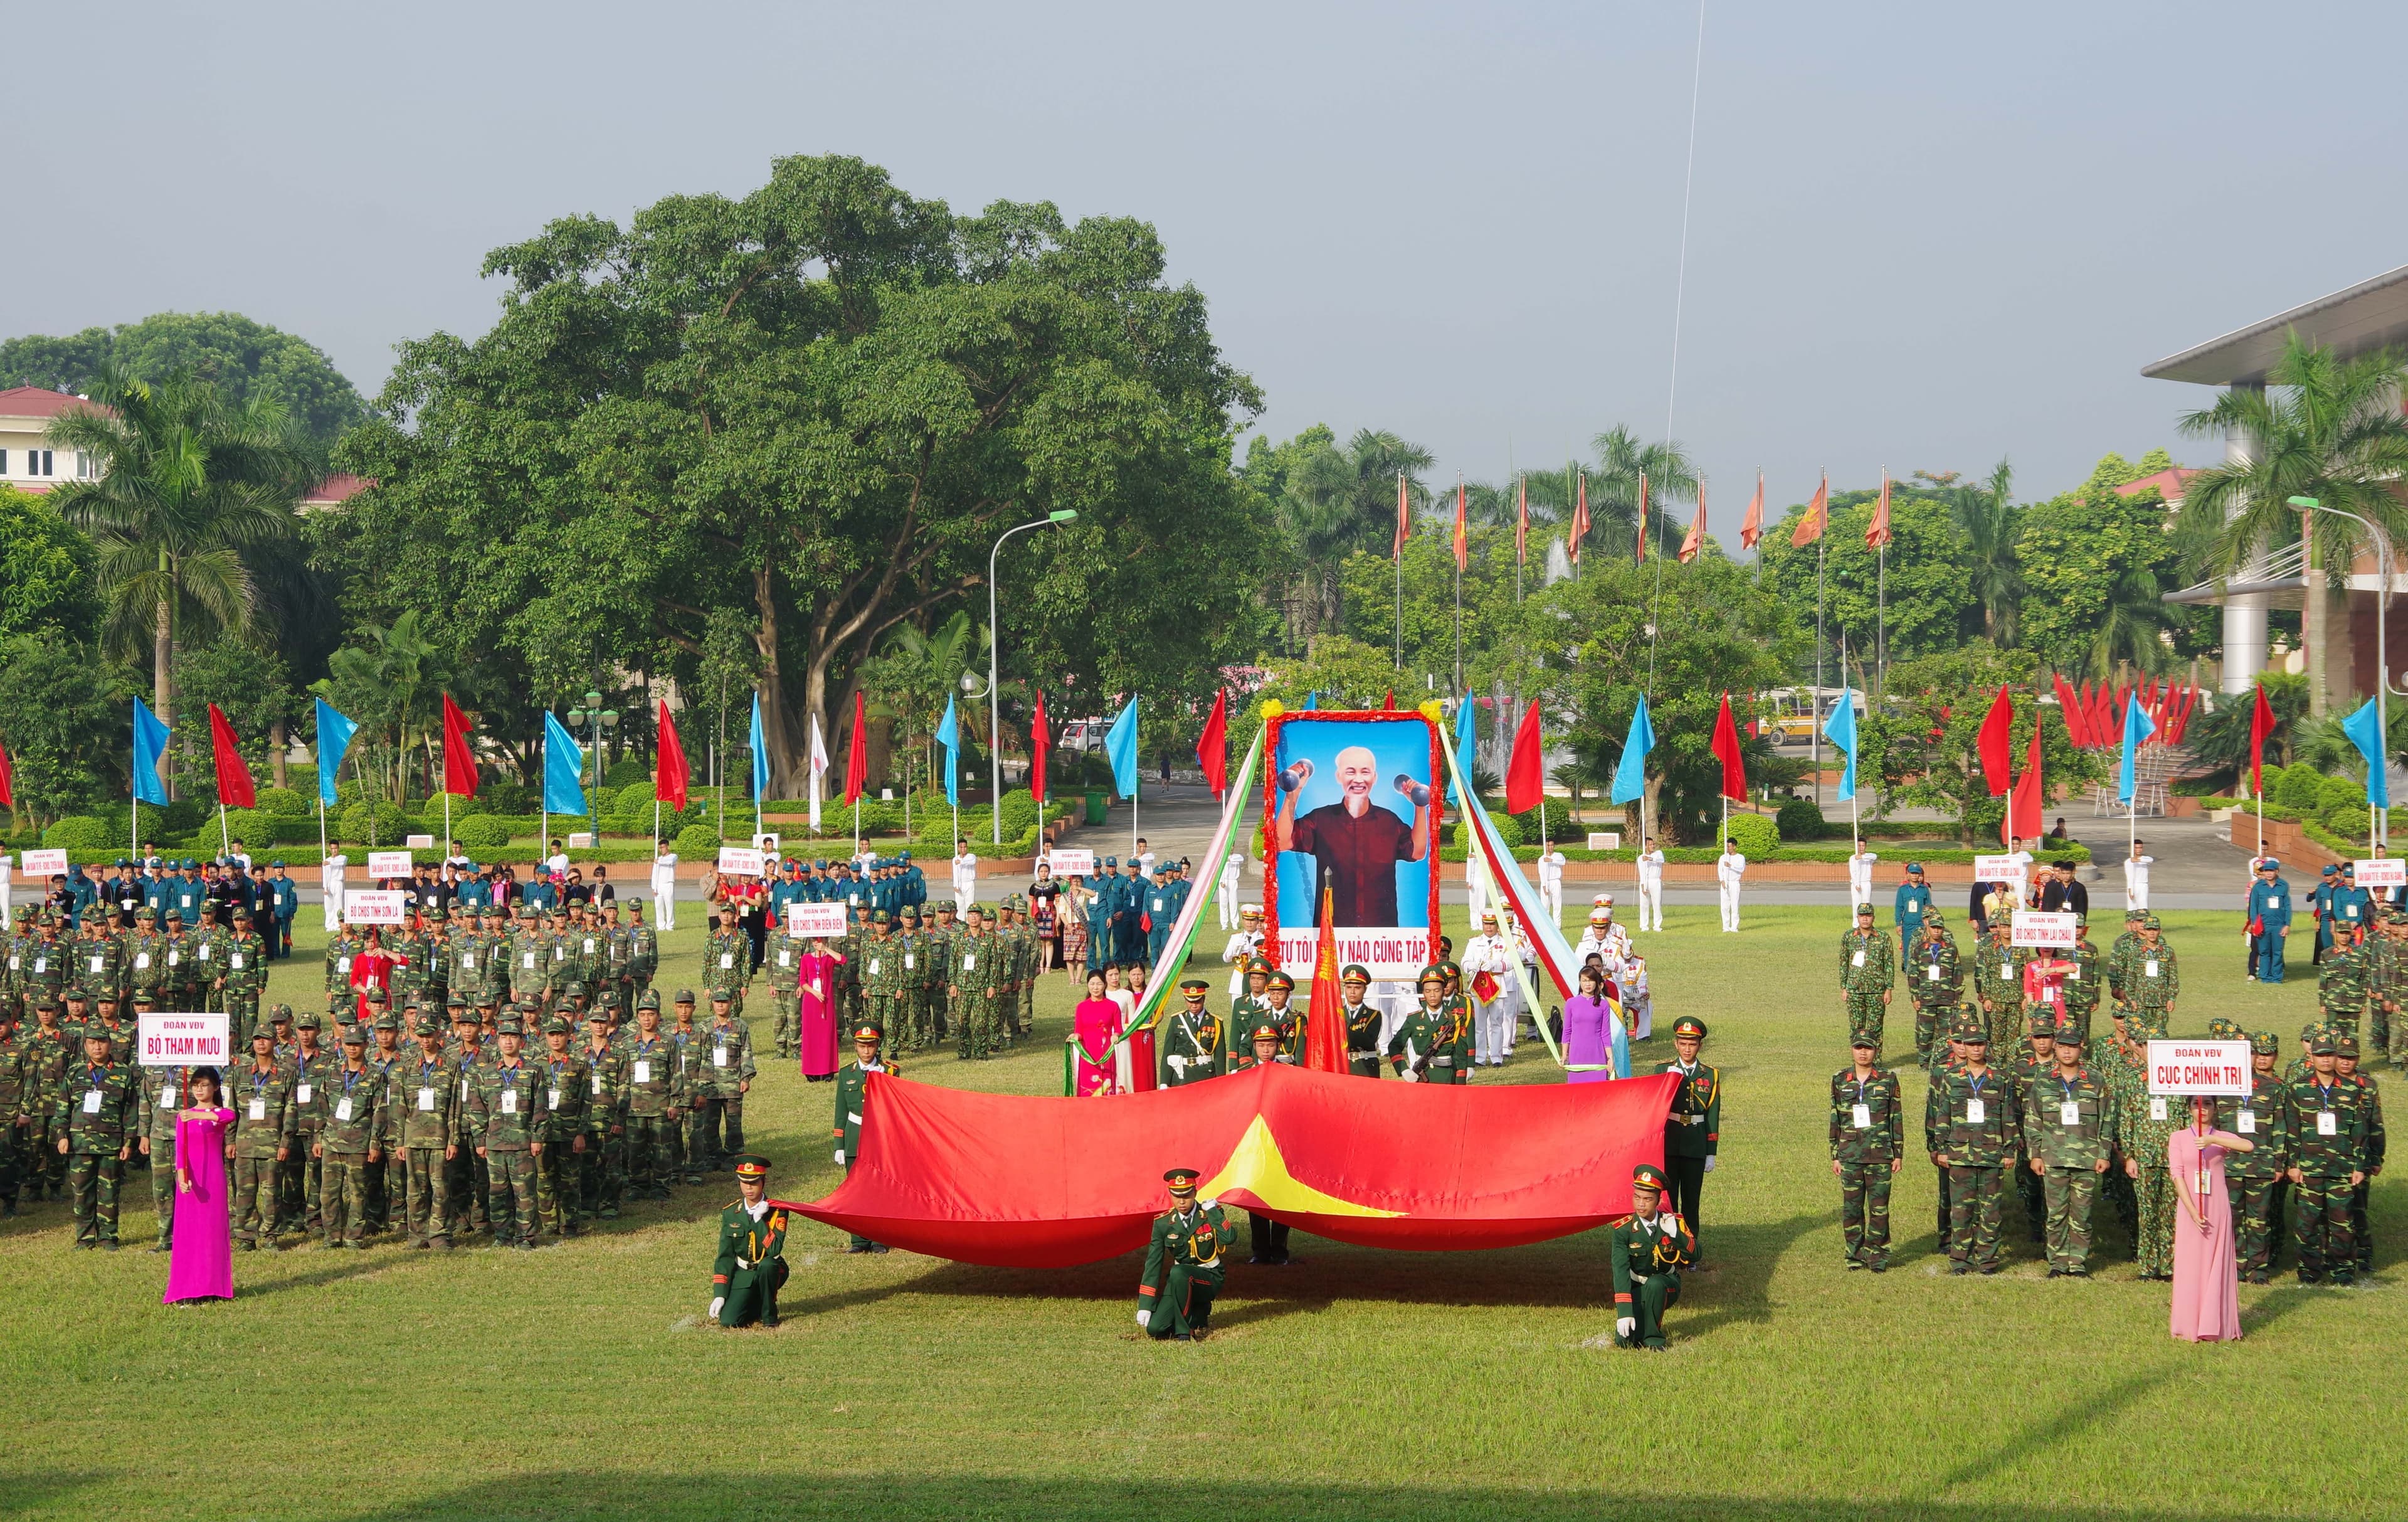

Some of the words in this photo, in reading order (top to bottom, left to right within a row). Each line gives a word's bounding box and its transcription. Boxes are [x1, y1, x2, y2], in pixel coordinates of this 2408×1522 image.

[1280, 938, 1294, 968] TỰ
[1296, 935, 1312, 963] TÔI
[1348, 935, 1370, 963] NÀO
[1374, 936, 1402, 963] CŨNG
[164, 1019, 186, 1029] ĐOÀN
[148, 1033, 161, 1059] BỘ
[165, 1037, 193, 1055] THAM
[198, 1036, 220, 1055] MƯU
[2175, 1047, 2201, 1057] ĐOÀN
[2204, 1049, 2222, 1057] VĐV
[2158, 1065, 2181, 1089] CỤC
[2185, 1062, 2221, 1084] CHÍNH
[2224, 1067, 2242, 1089] TRỊ
